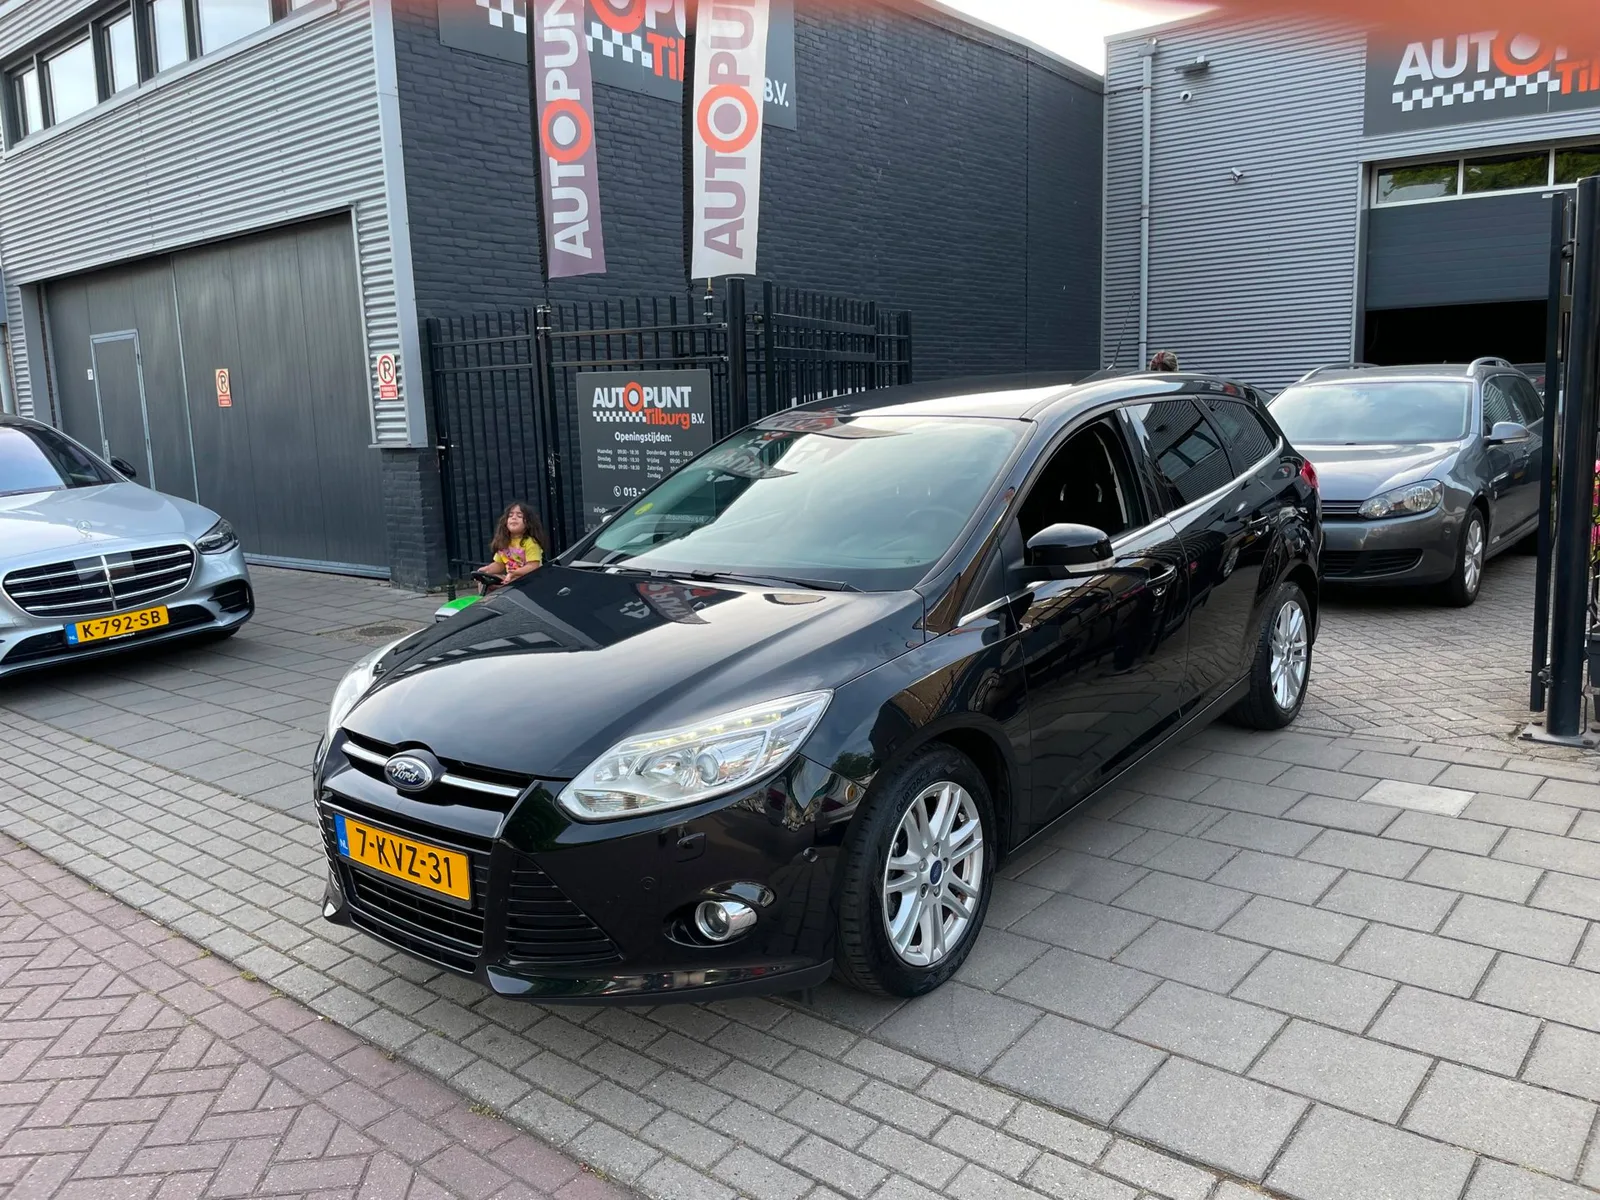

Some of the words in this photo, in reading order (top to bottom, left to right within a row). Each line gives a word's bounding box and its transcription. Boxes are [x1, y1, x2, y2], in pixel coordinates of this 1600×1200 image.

[1393, 28, 1567, 85] AUTO
[541, 0, 593, 259] AUTOPUN
[697, 0, 758, 259] AUTOPU
[592, 381, 692, 412] AUTOPUNT
[644, 408, 690, 429] Tilburg
[691, 413, 705, 424] B.V.
[614, 431, 672, 443] Openingstijden:
[82, 610, 161, 638] K-792-SB
[392, 761, 419, 783] Ford
[340, 838, 349, 850] NL
[355, 827, 453, 889] 7-KVZ-31
